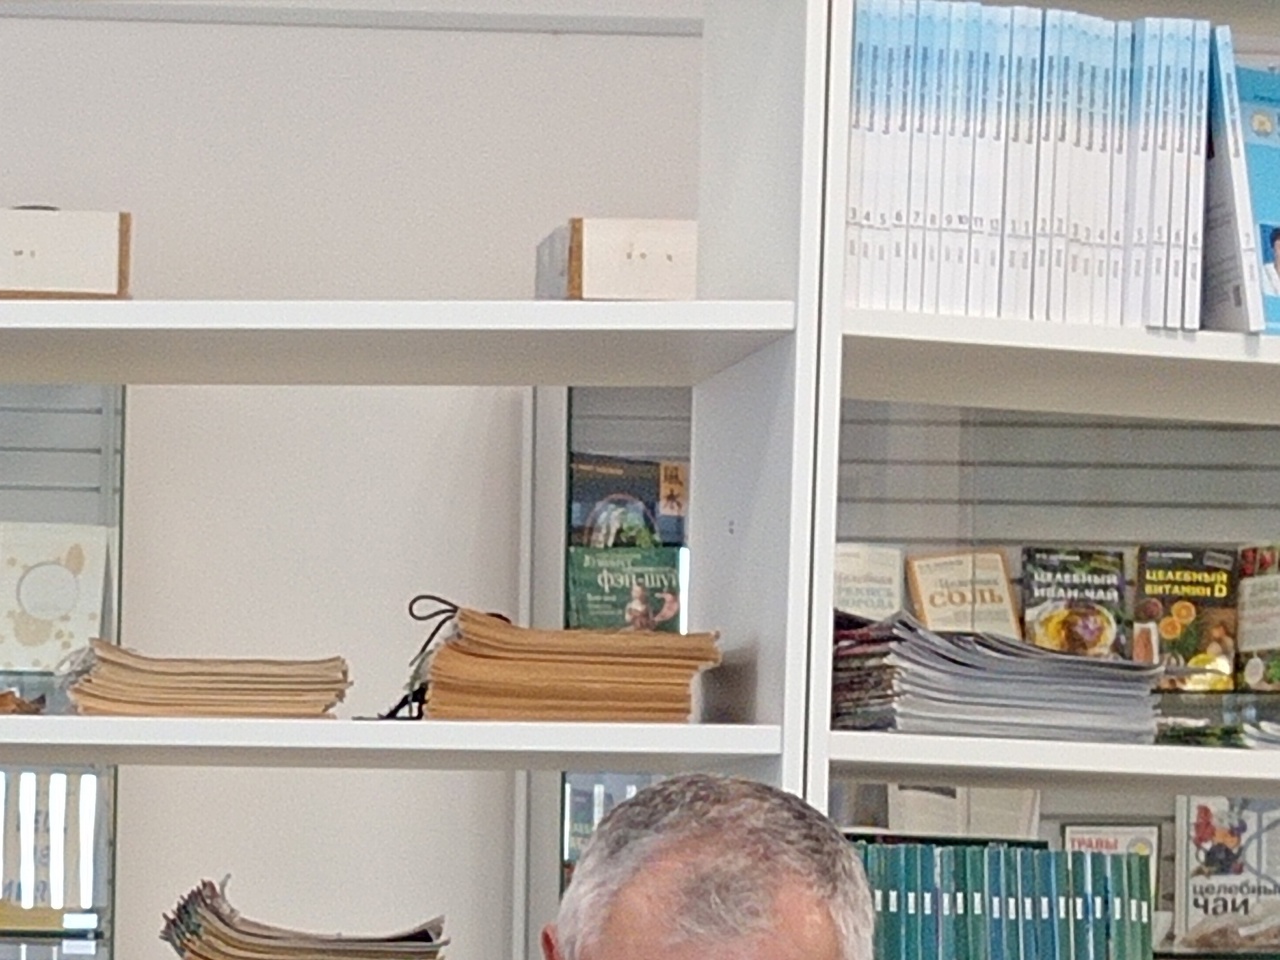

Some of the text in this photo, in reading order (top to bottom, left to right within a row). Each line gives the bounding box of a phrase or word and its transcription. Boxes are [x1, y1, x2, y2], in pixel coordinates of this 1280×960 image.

[929, 588, 1004, 608] СОЛЬ
[1214, 585, 1228, 598] D
[1192, 880, 1280, 895] целебны
